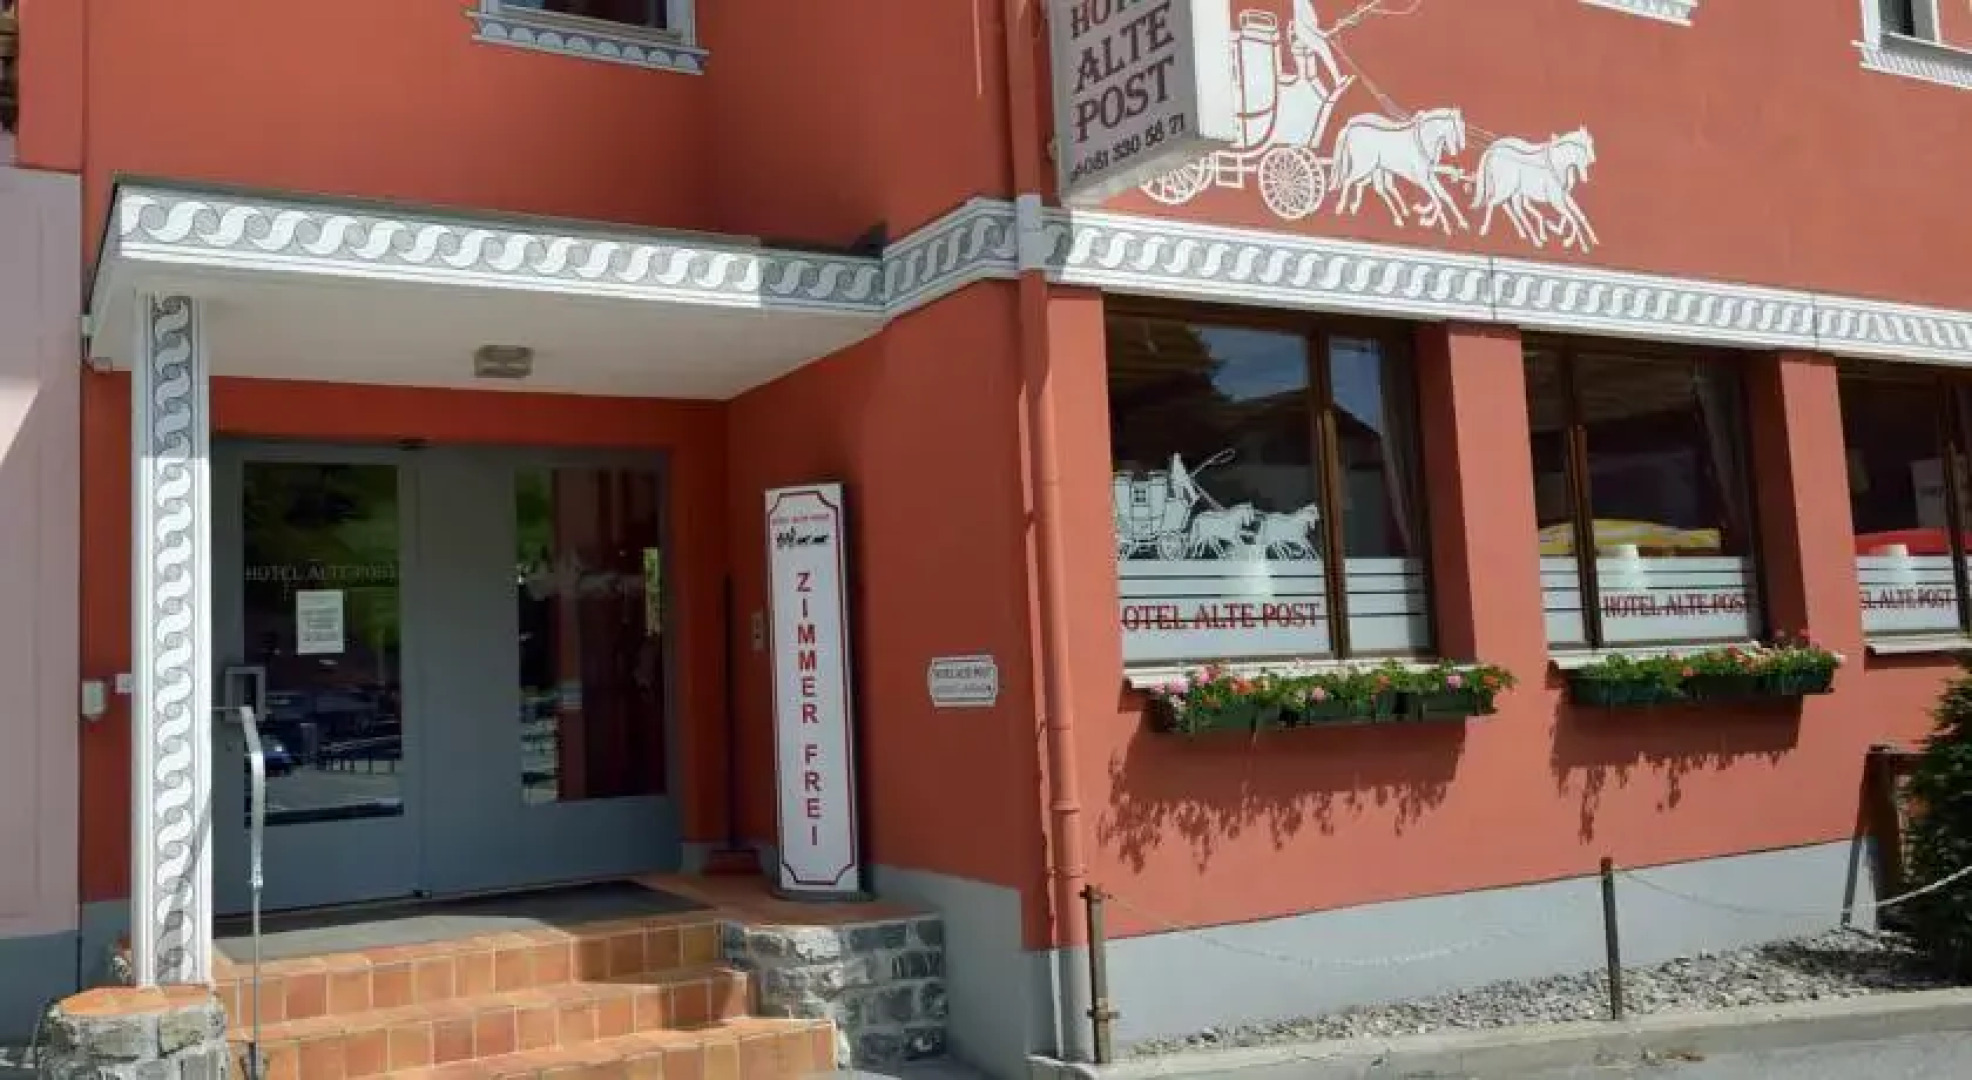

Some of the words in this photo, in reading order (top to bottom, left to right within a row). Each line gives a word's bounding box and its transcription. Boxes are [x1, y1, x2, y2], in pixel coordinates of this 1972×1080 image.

[1074, 1, 1175, 94] ALTE
[1072, 54, 1175, 143] POST
[1194, 602, 1257, 628] ALTE
[1262, 602, 1320, 627] POST
[1604, 594, 1660, 617] HOTEL
[1666, 593, 1710, 616] ALTE
[1880, 588, 1917, 608] ALTE
[1918, 588, 1952, 608] POST
[796, 572, 820, 724] ZIMMER
[804, 744, 822, 846] FREI
